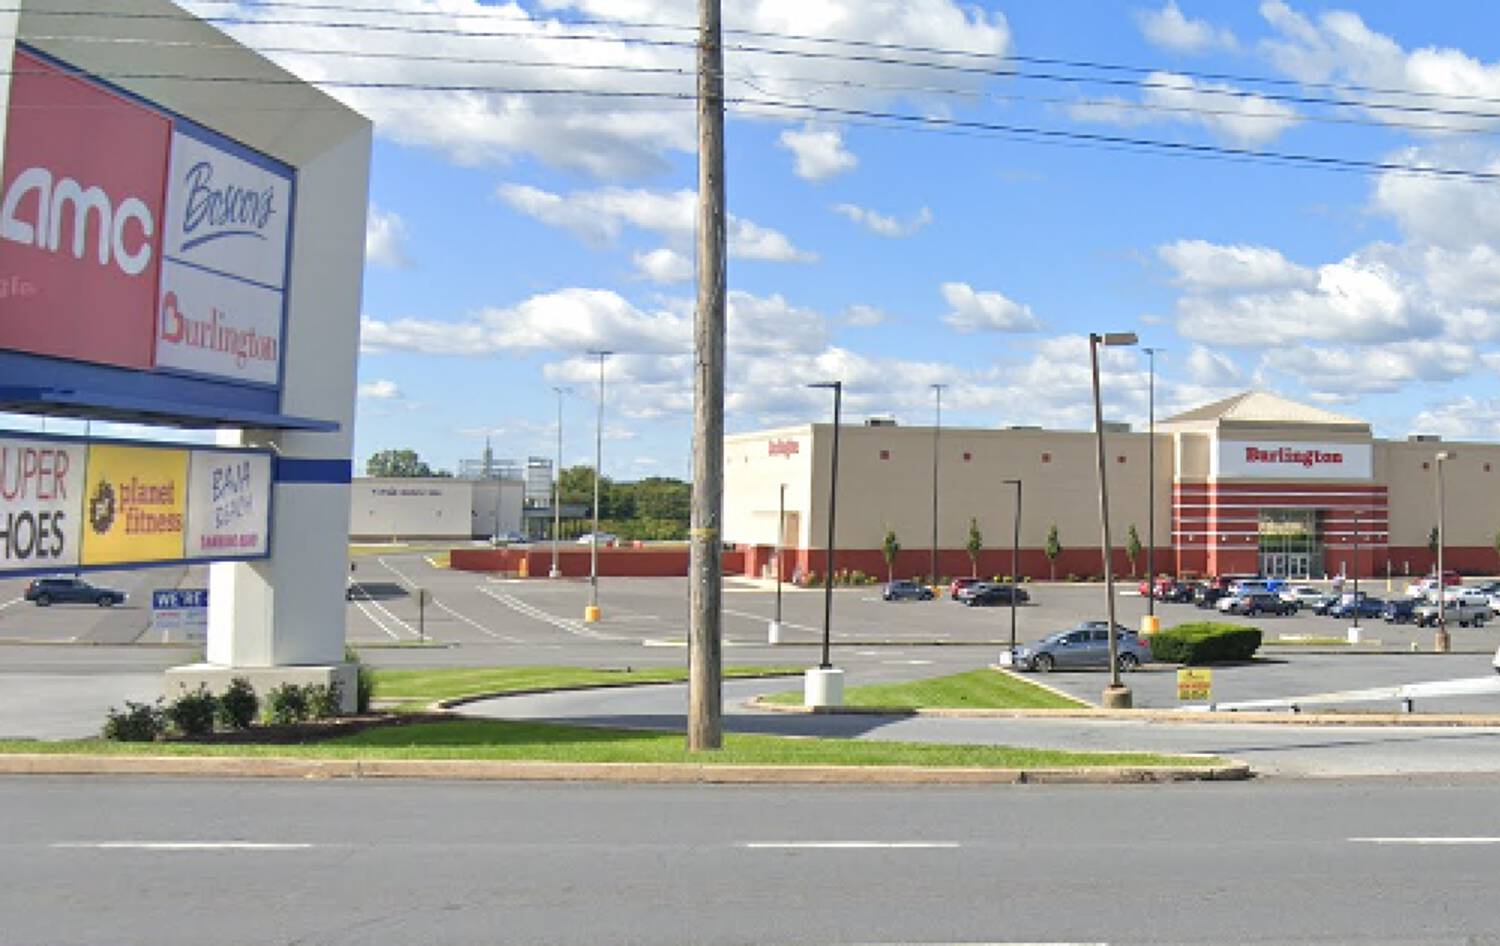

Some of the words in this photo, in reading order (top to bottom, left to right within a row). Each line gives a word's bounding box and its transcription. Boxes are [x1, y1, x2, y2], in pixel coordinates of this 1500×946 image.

[161, 290, 277, 368] Burlington
[1245, 447, 1343, 468] Burlington
[120, 477, 174, 512] planet
[126, 507, 182, 535] fitness
